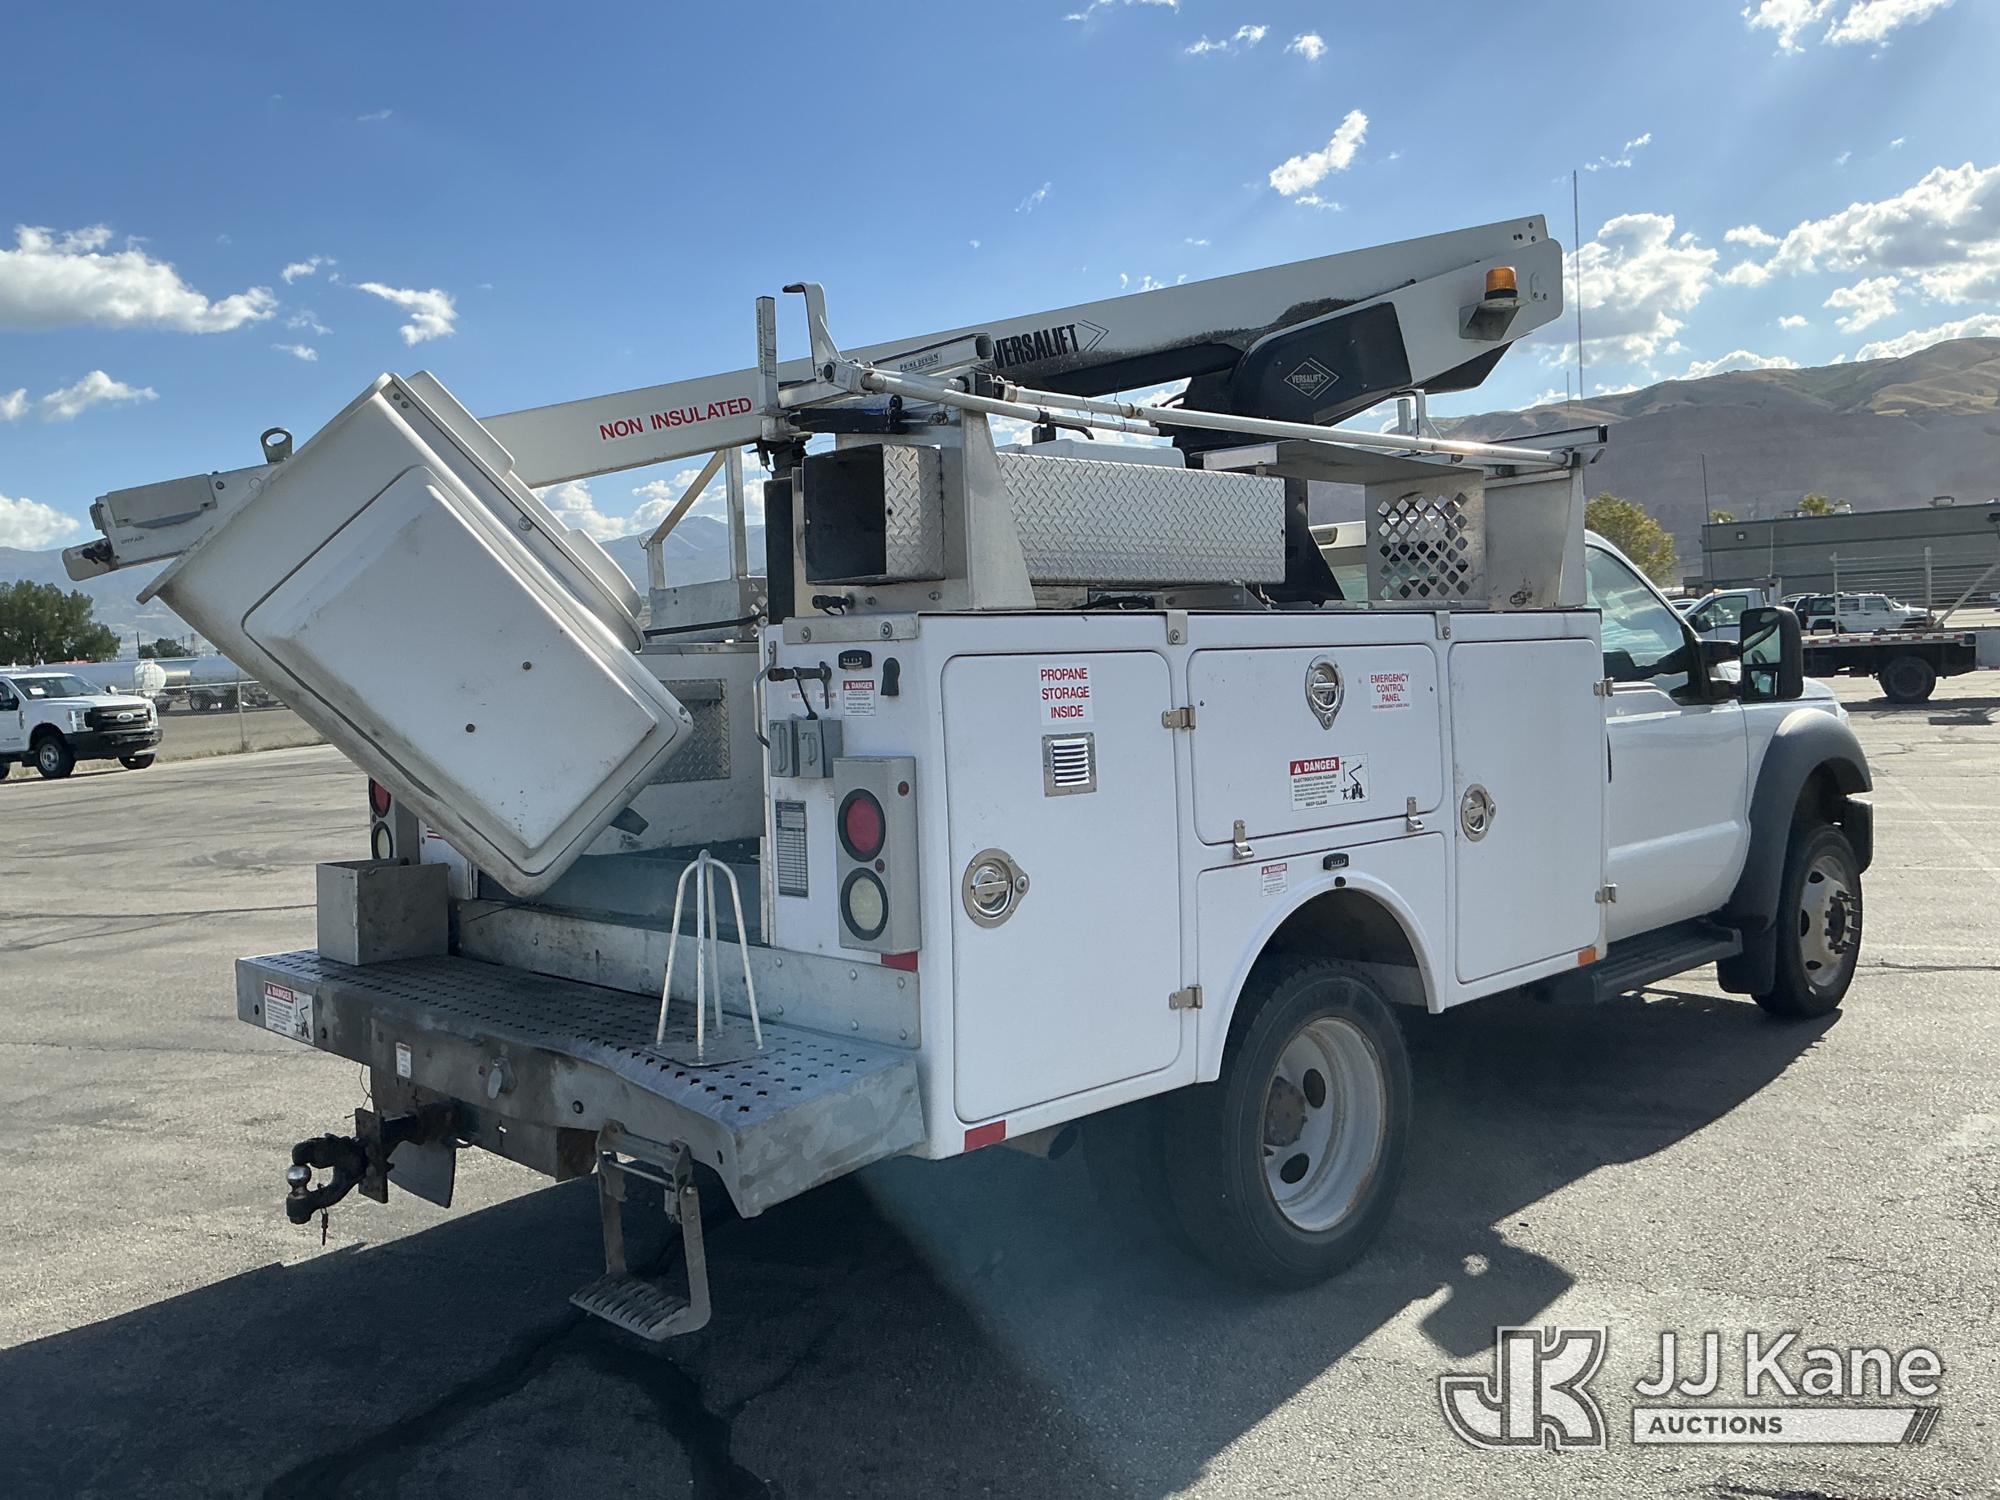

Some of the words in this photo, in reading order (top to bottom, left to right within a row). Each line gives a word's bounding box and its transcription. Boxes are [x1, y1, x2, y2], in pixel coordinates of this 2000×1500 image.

[992, 324, 1079, 369] VERSALIFT
[1291, 374, 1322, 384] VERSALIFT
[599, 417, 643, 440] NON
[650, 397, 752, 430] INSULATED
[1040, 667, 1088, 681] PROPANE
[1370, 673, 1409, 683] EMERGENCY
[851, 682, 874, 690] DANGER
[1376, 683, 1405, 693] CONTROL
[1041, 686, 1090, 700] STORAGE
[1381, 693, 1401, 702] PANEL
[1050, 705, 1084, 718] INSIDE
[1303, 759, 1337, 773] DANGER
[272, 986, 293, 1001] DANGER
